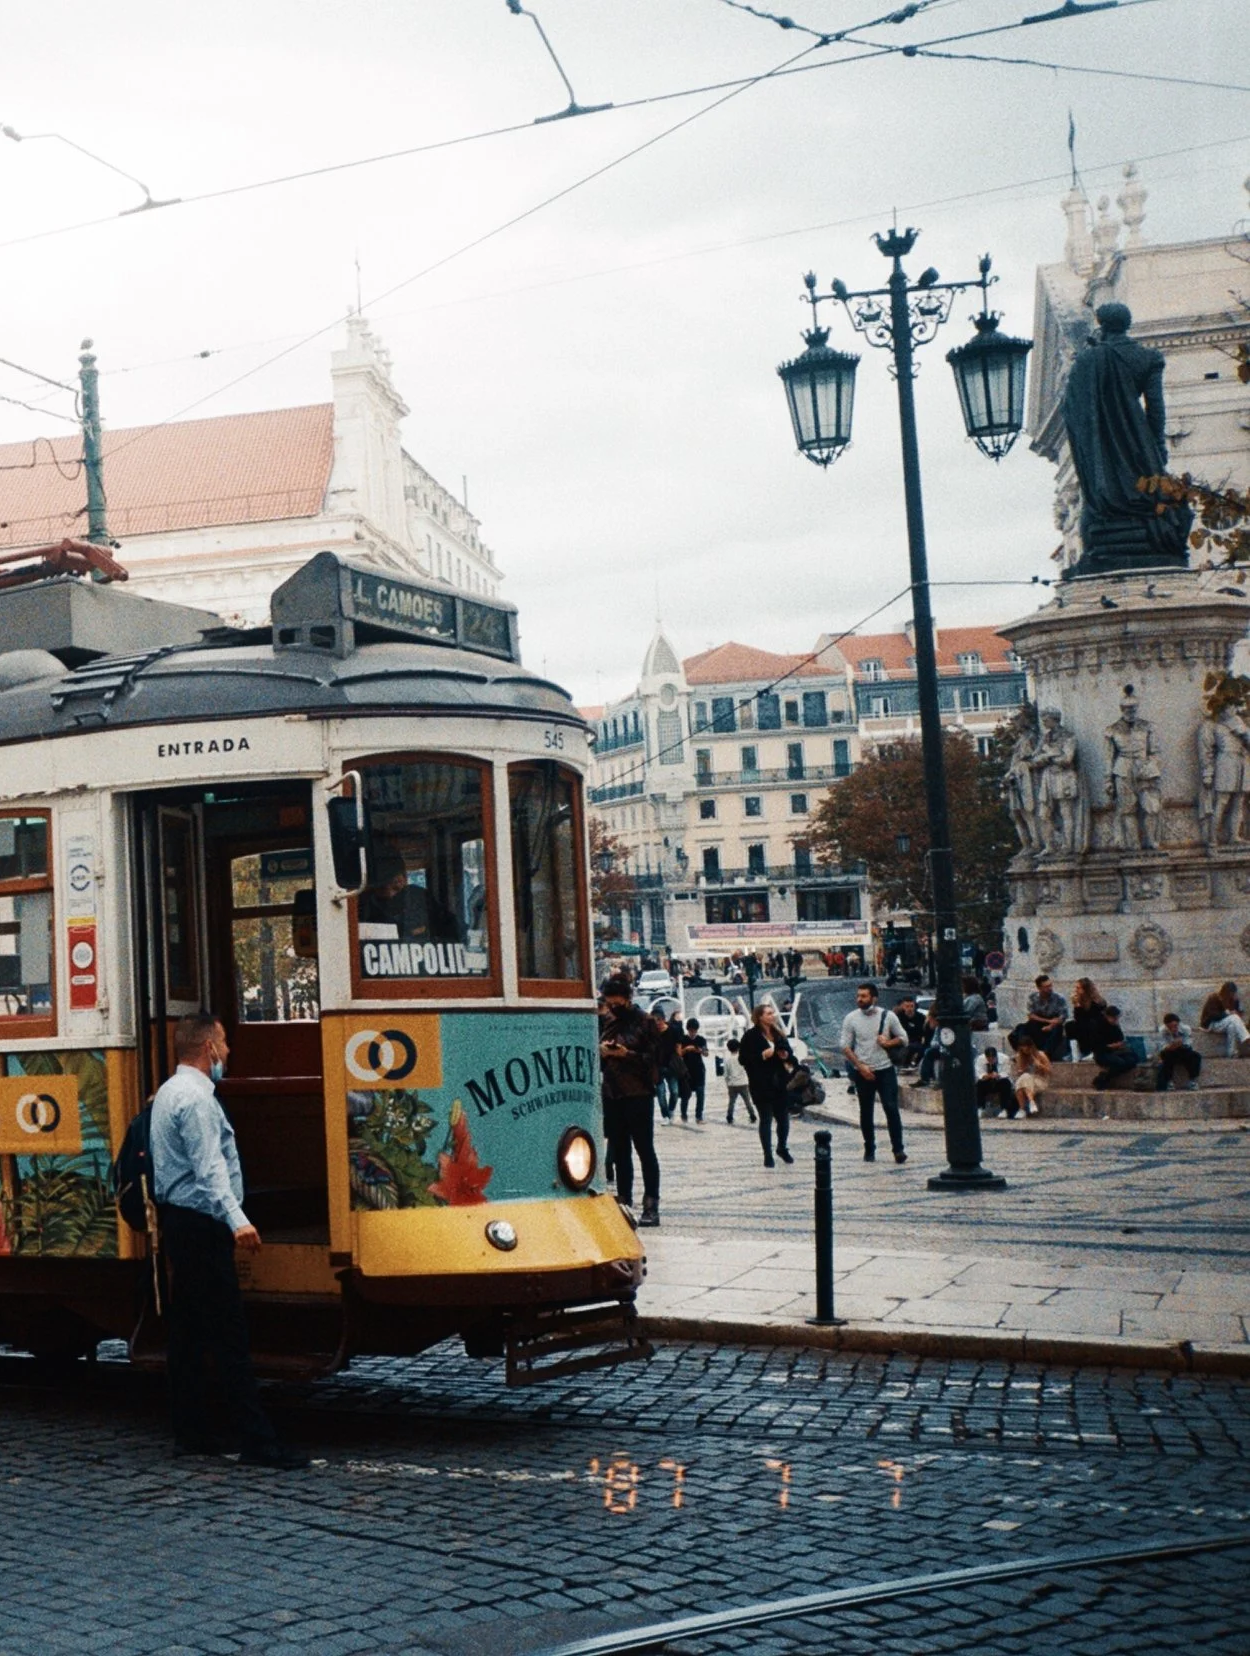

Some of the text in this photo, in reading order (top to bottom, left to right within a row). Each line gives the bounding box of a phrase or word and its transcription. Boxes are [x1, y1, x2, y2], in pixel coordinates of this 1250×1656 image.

[376, 584, 444, 626] CAMOES
[158, 737, 250, 757] ENTRADA
[545, 730, 564, 750] 545
[363, 943, 483, 976] CAMPOLID
